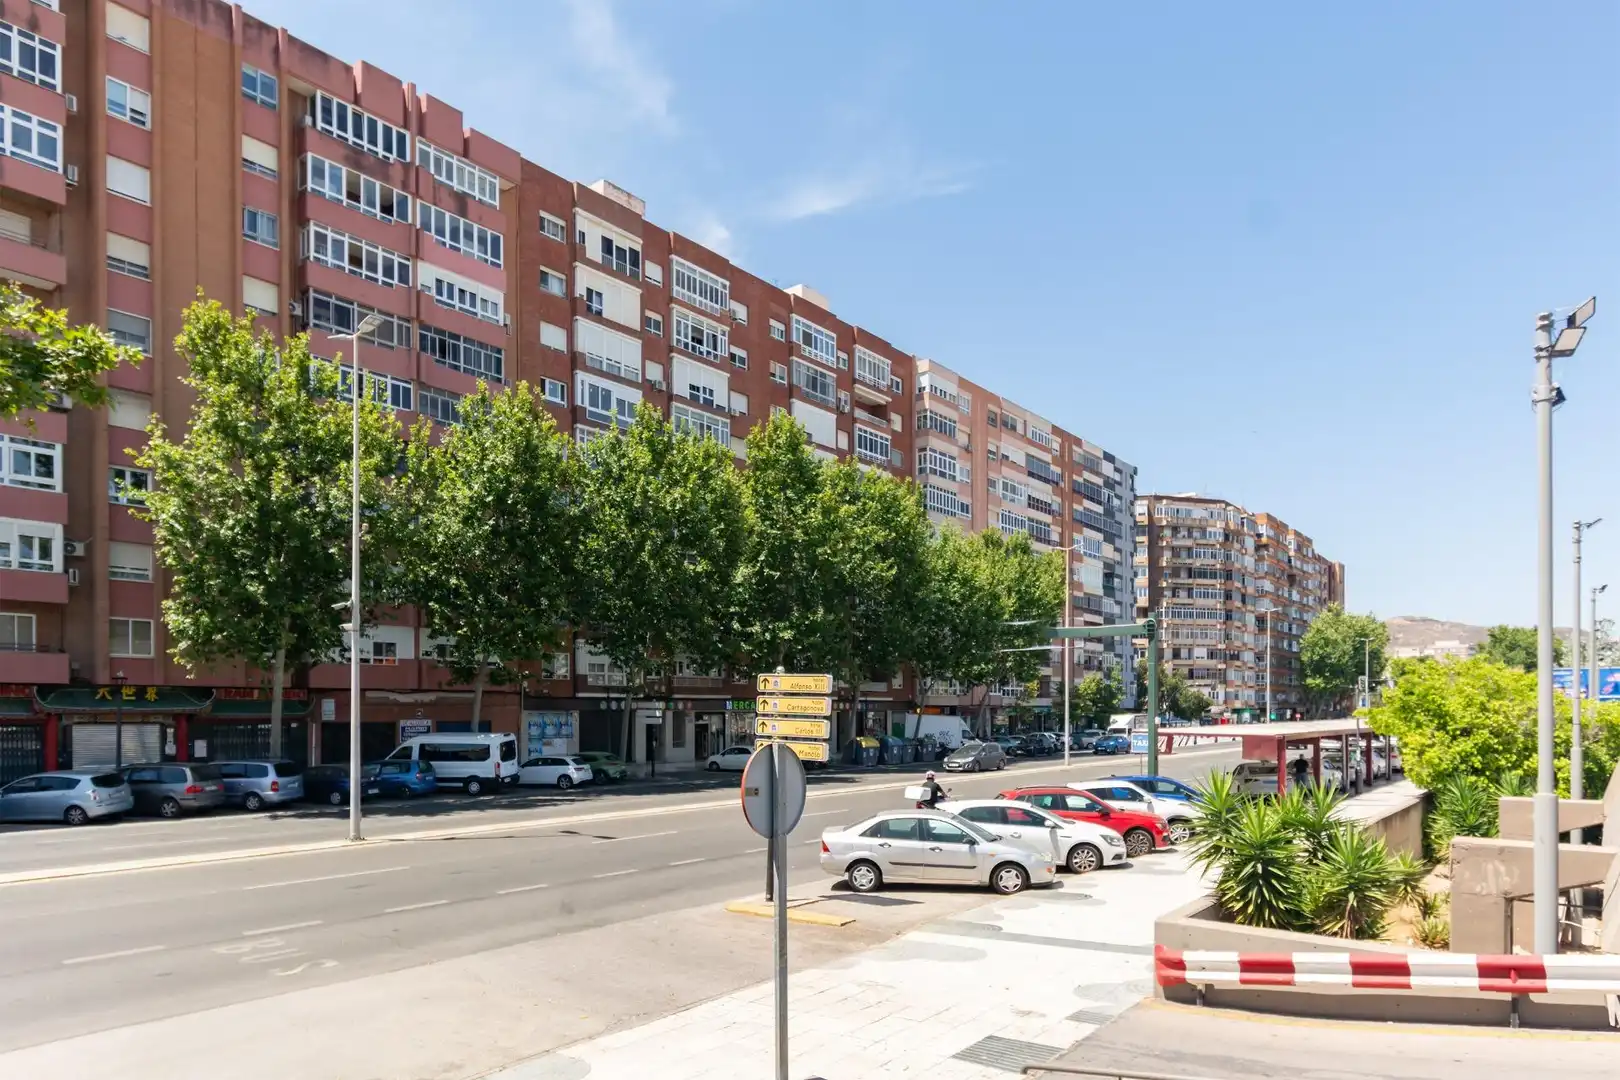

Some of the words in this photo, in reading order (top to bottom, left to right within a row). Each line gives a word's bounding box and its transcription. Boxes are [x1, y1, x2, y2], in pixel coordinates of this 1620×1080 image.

[790, 682, 812, 690] Alfonso
[786, 704, 824, 713] Cartagonova
[211, 937, 340, 977] BUS
